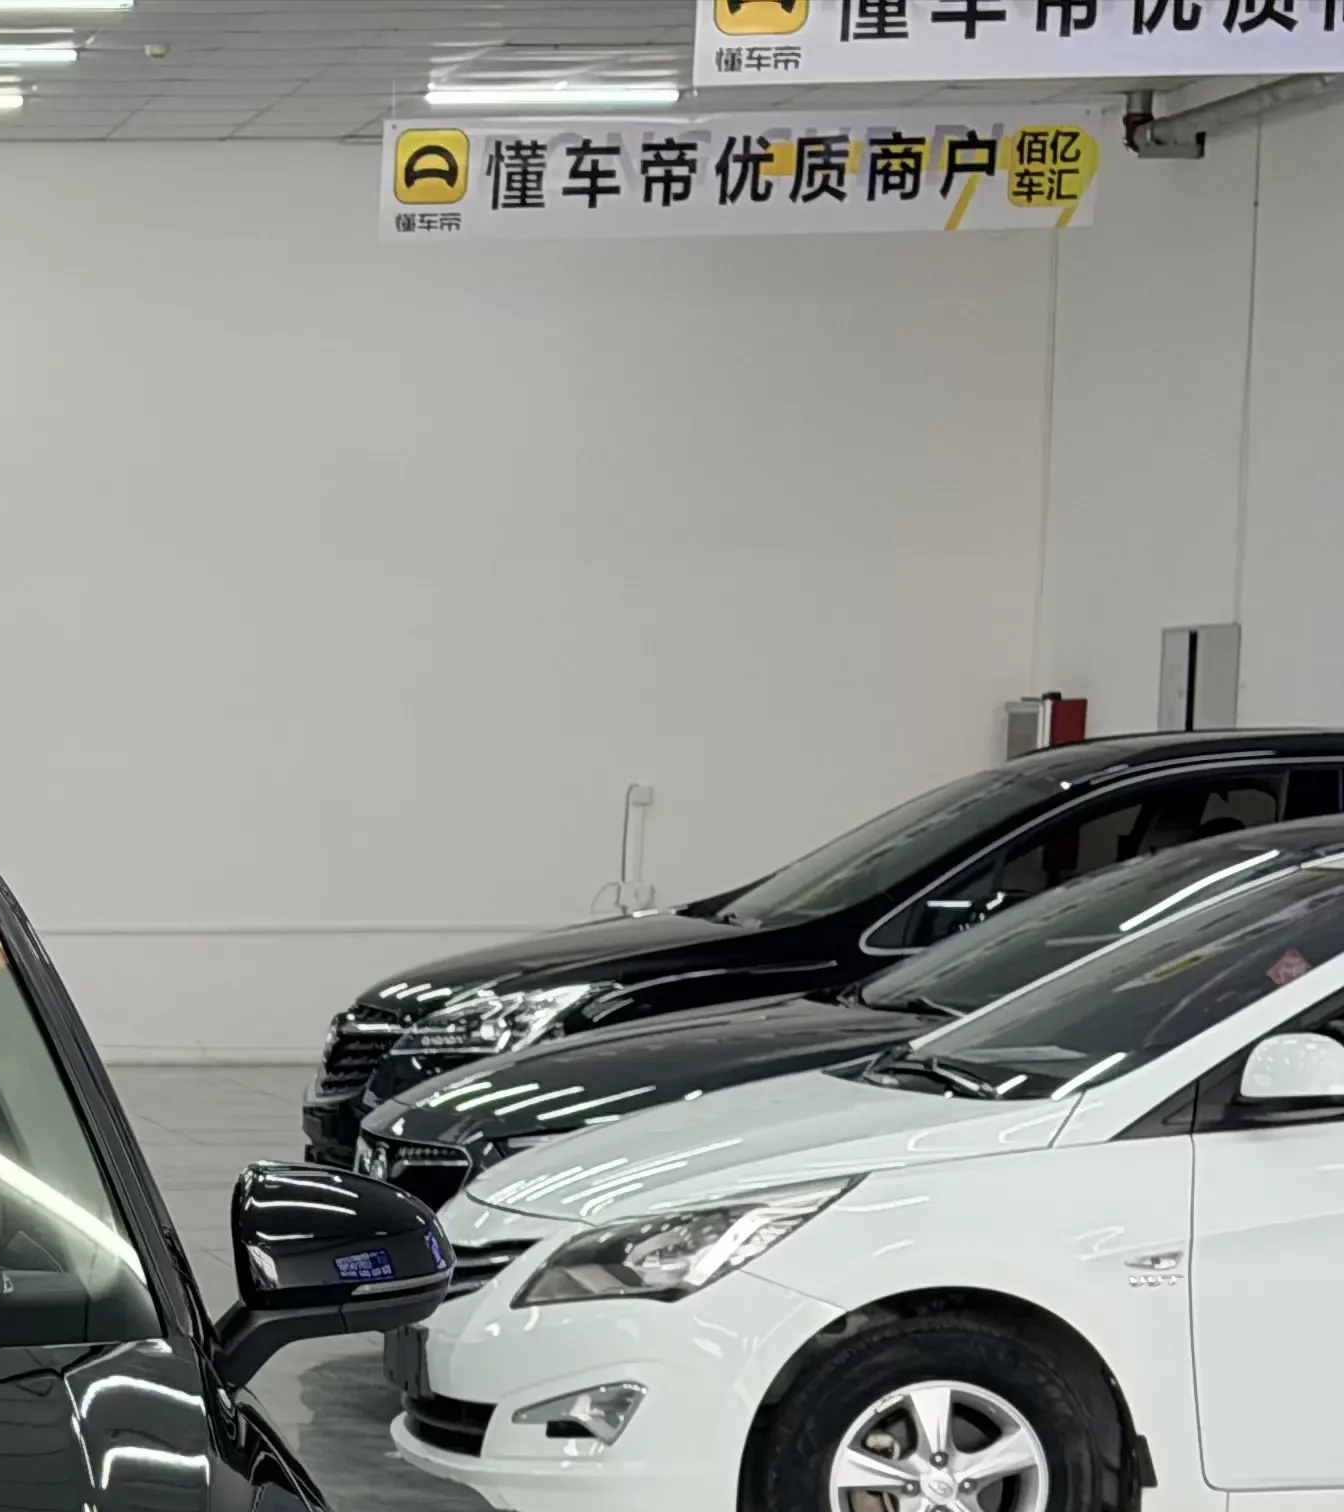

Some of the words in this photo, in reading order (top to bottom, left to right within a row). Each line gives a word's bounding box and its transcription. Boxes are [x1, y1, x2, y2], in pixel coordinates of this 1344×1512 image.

[716, 46, 801, 72] 懂车帝
[1015, 130, 1081, 165] 佰亿
[485, 129, 998, 210] 懂车帝优质商户
[1012, 168, 1080, 204] 车汇
[395, 212, 462, 232] 懂车帝
